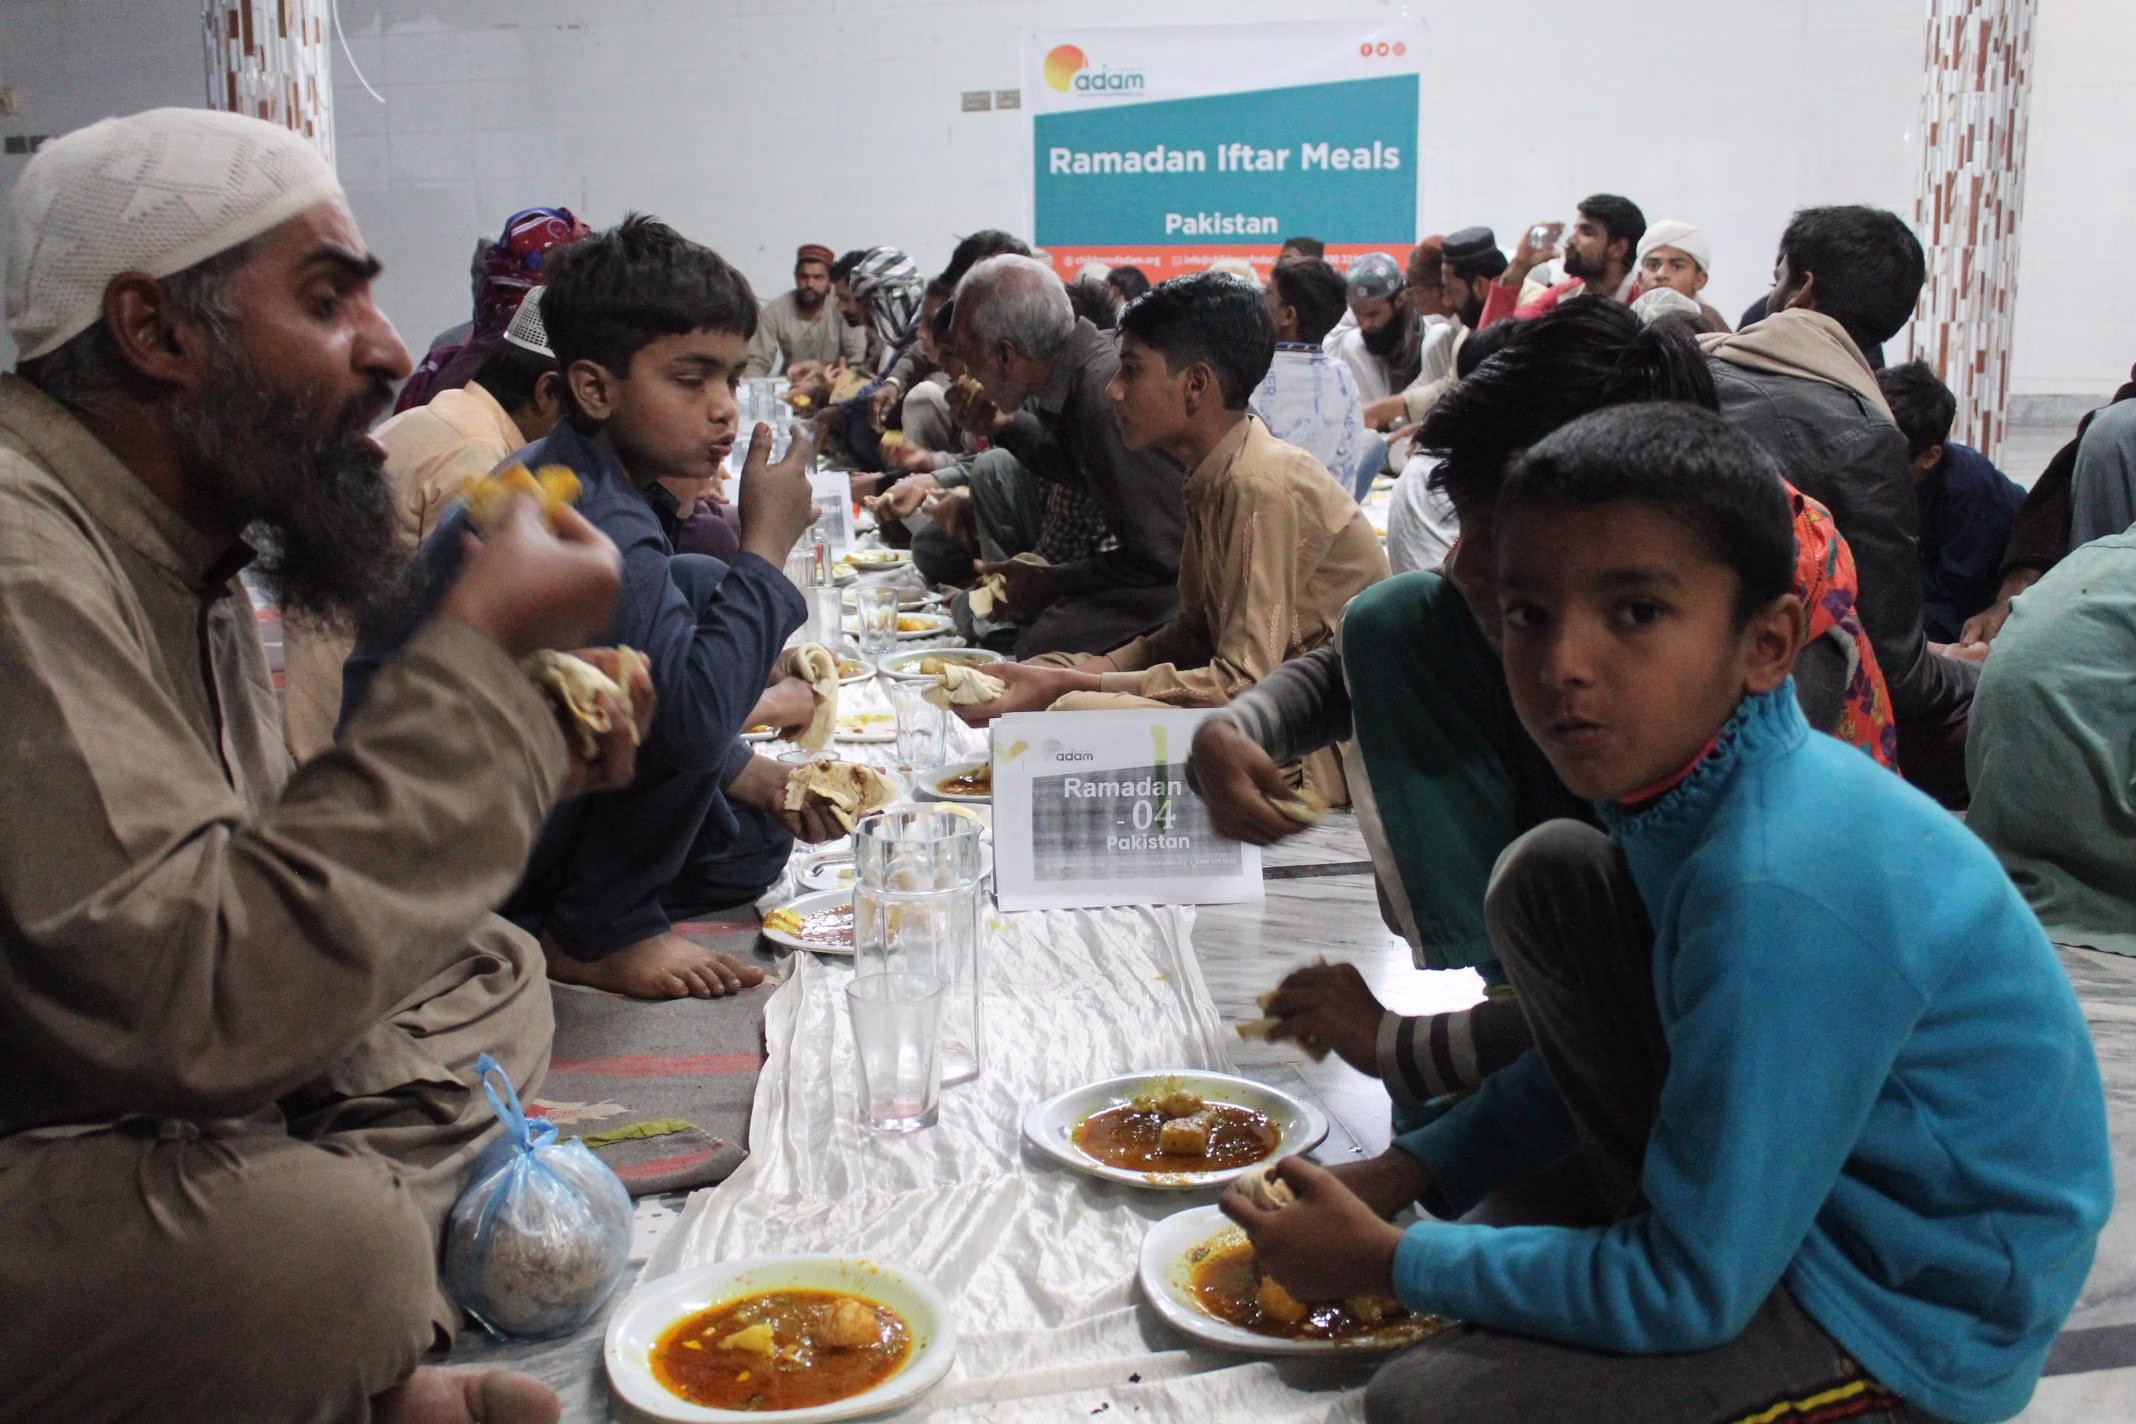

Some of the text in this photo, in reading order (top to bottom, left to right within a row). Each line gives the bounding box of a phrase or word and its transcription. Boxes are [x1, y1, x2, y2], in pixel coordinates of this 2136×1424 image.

[1074, 71, 1144, 91] adam
[1050, 140, 1400, 174] Ramadan Iftar Meals
[1165, 211, 1279, 235] Pakistan
[1055, 751, 1094, 762] adam
[1064, 776, 1182, 798] Ramadan
[1106, 833, 1190, 850] Pakistan
